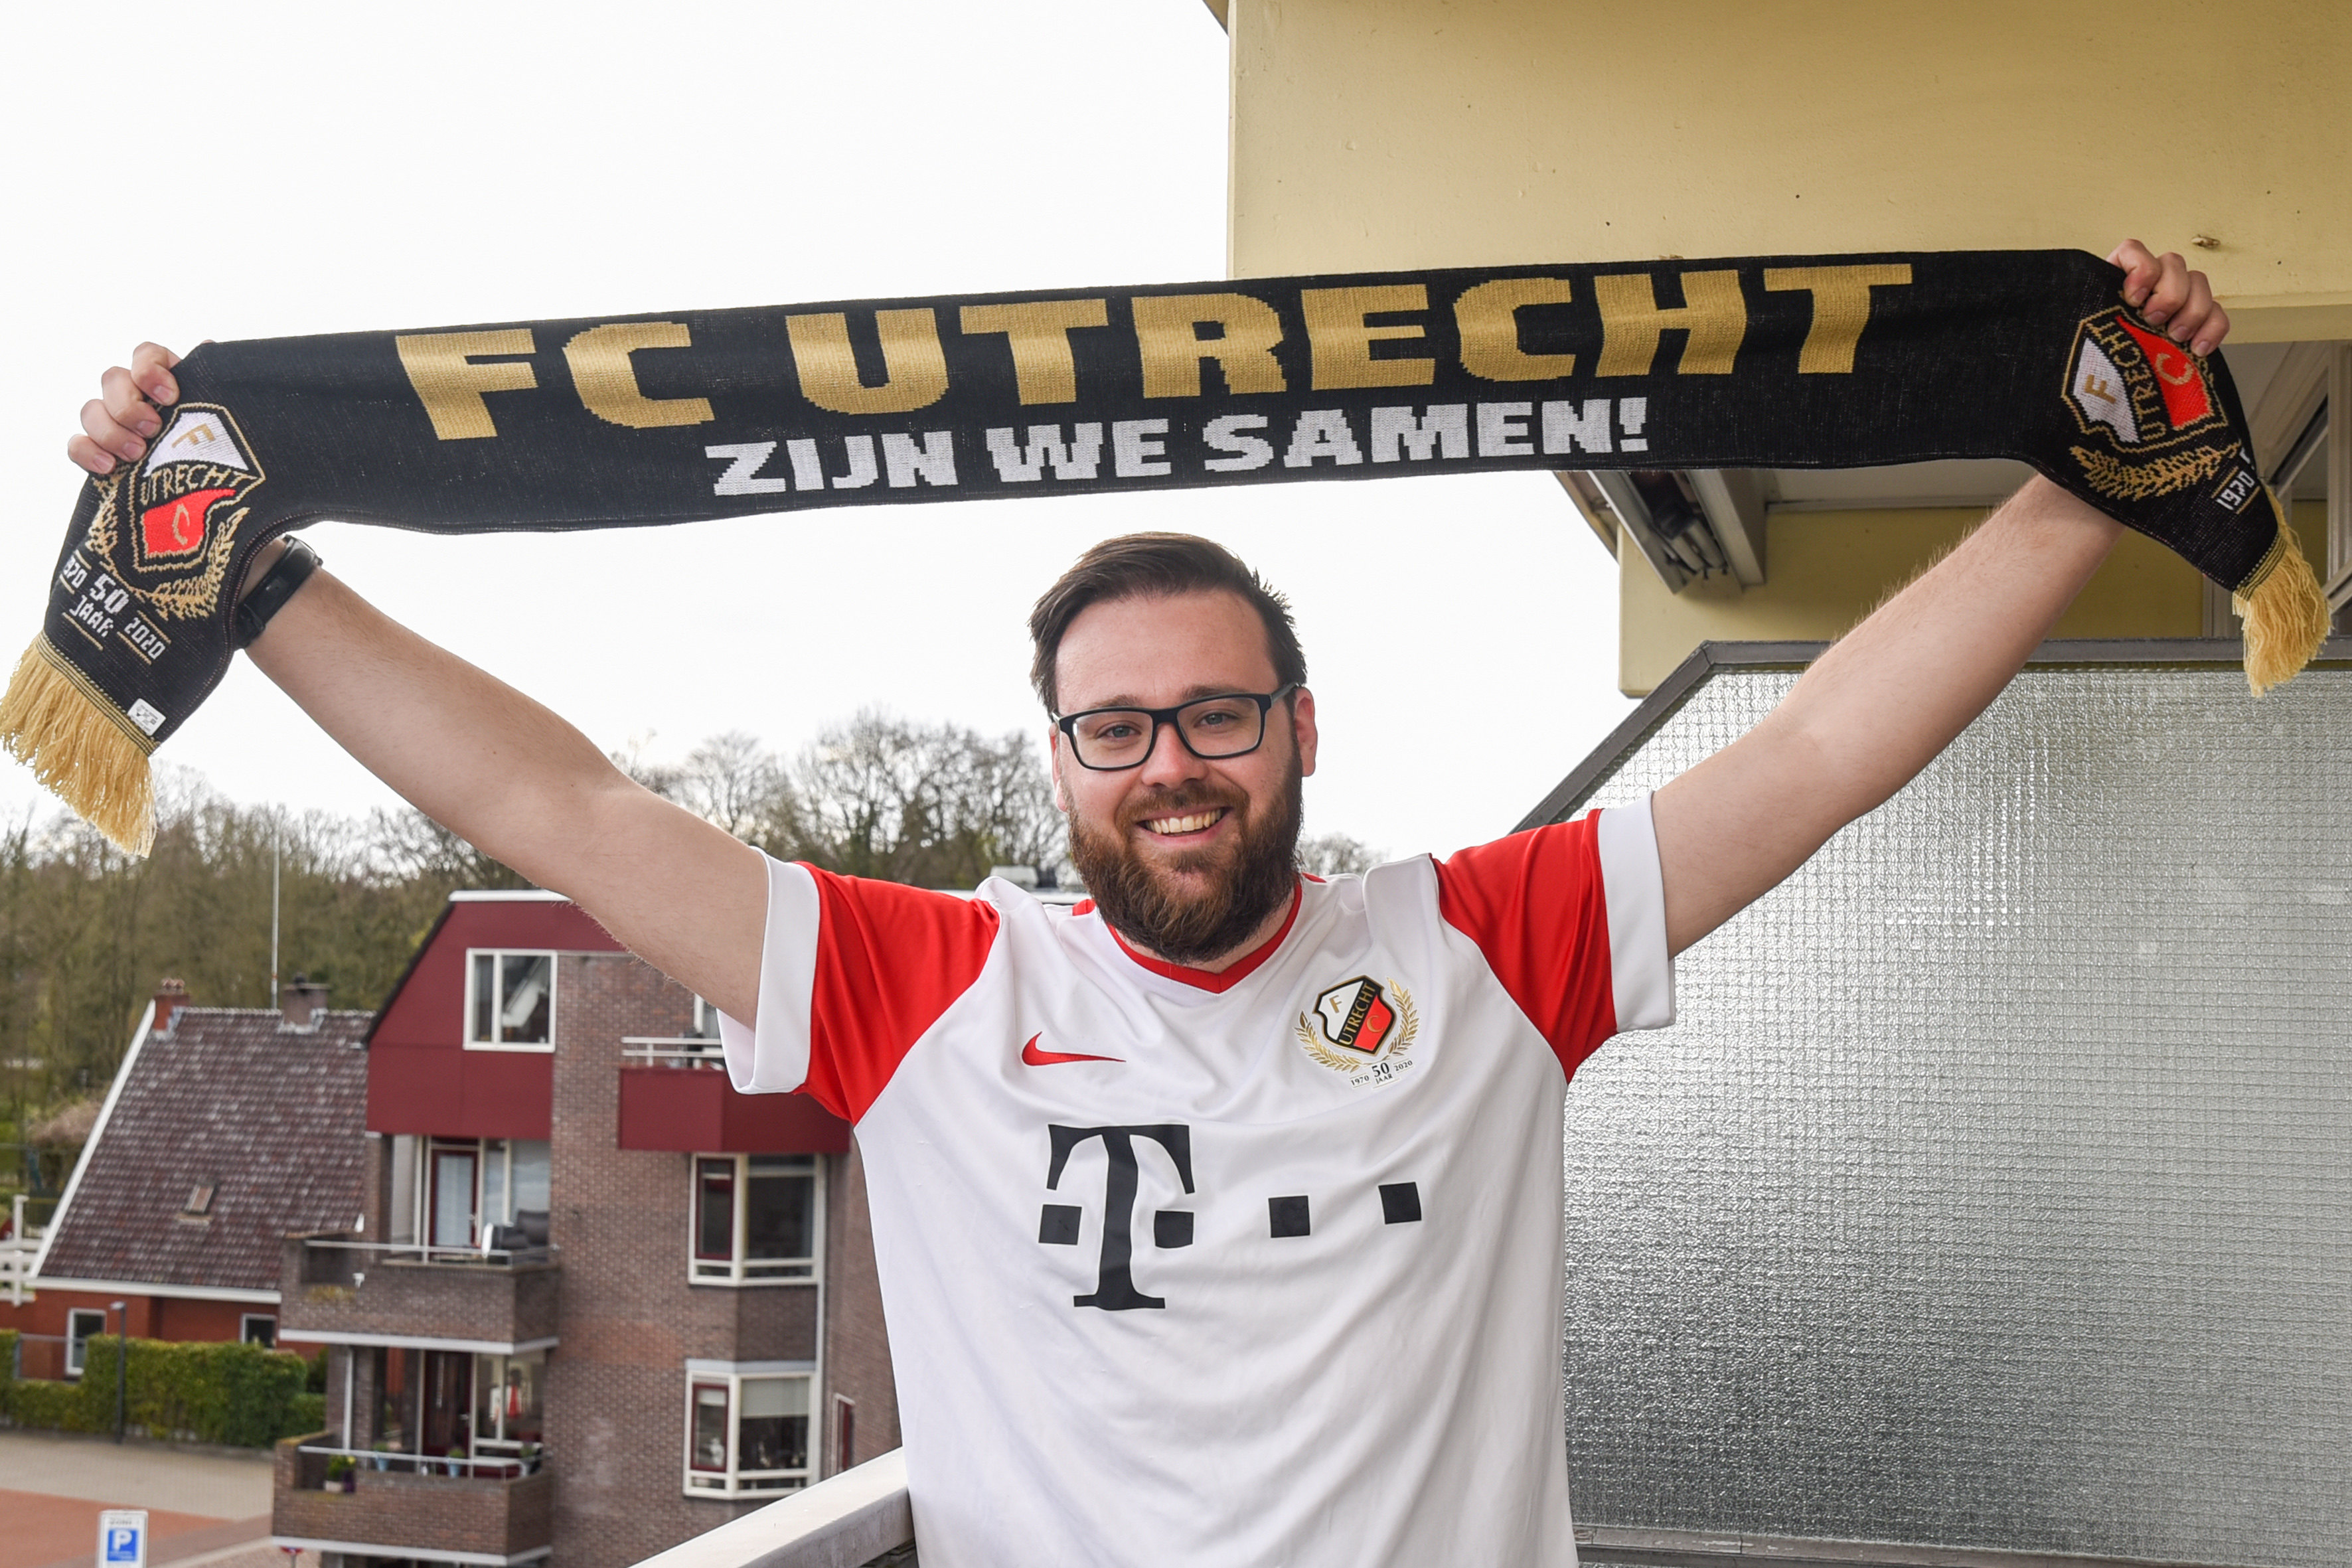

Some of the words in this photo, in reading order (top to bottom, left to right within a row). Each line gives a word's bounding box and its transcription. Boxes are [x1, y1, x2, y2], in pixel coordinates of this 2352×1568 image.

[396, 321, 715, 440] FC
[785, 264, 1913, 416] UTRECHT
[2155, 353, 2193, 386] C
[2084, 374, 2116, 404] F
[2086, 321, 2167, 441] UTRECHT
[172, 423, 216, 448] F
[705, 431, 959, 496] ZIJN
[985, 418, 1172, 483] WE
[1202, 397, 1648, 472] SAMEN!
[140, 464, 258, 506] UTRECHT
[2215, 471, 2255, 510] 1970
[69, 595, 114, 637] JAAR
[90, 574, 129, 614] 50
[124, 617, 165, 660] 2020
[1329, 994, 1342, 1014] F
[1339, 982, 1375, 1045] UTRECHT
[1367, 1015, 1384, 1033] C
[1351, 1075, 1370, 1086] 1970
[1372, 1062, 1389, 1077] 50
[1394, 1060, 1413, 1071] 2020
[1375, 1073, 1393, 1084] JAAR
[1046, 1124, 1195, 1311] T
[112, 1529, 133, 1551] P
